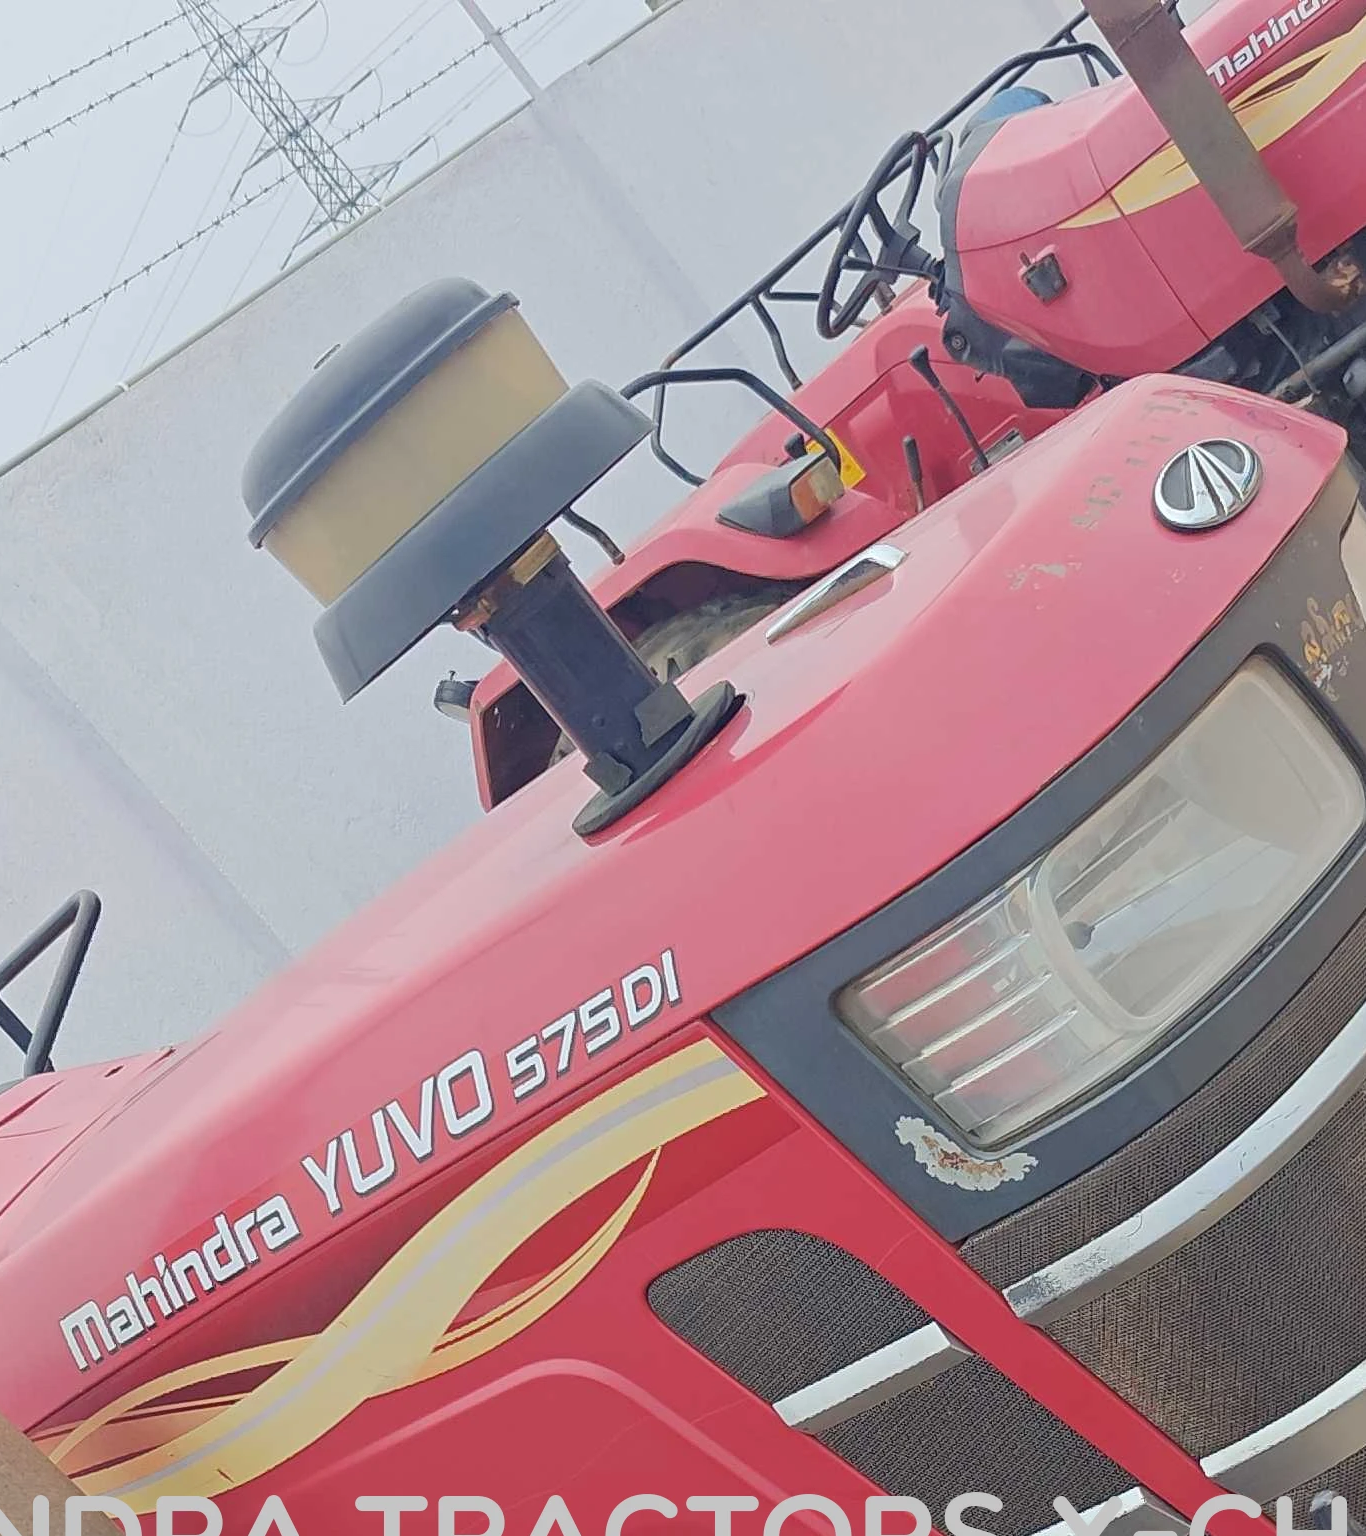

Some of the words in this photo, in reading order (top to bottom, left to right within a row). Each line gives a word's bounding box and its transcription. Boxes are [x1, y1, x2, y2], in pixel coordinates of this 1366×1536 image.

[1205, 0, 1329, 87] Mahind
[59, 1193, 302, 1372] Mahindra
[300, 1048, 494, 1216] YUVO
